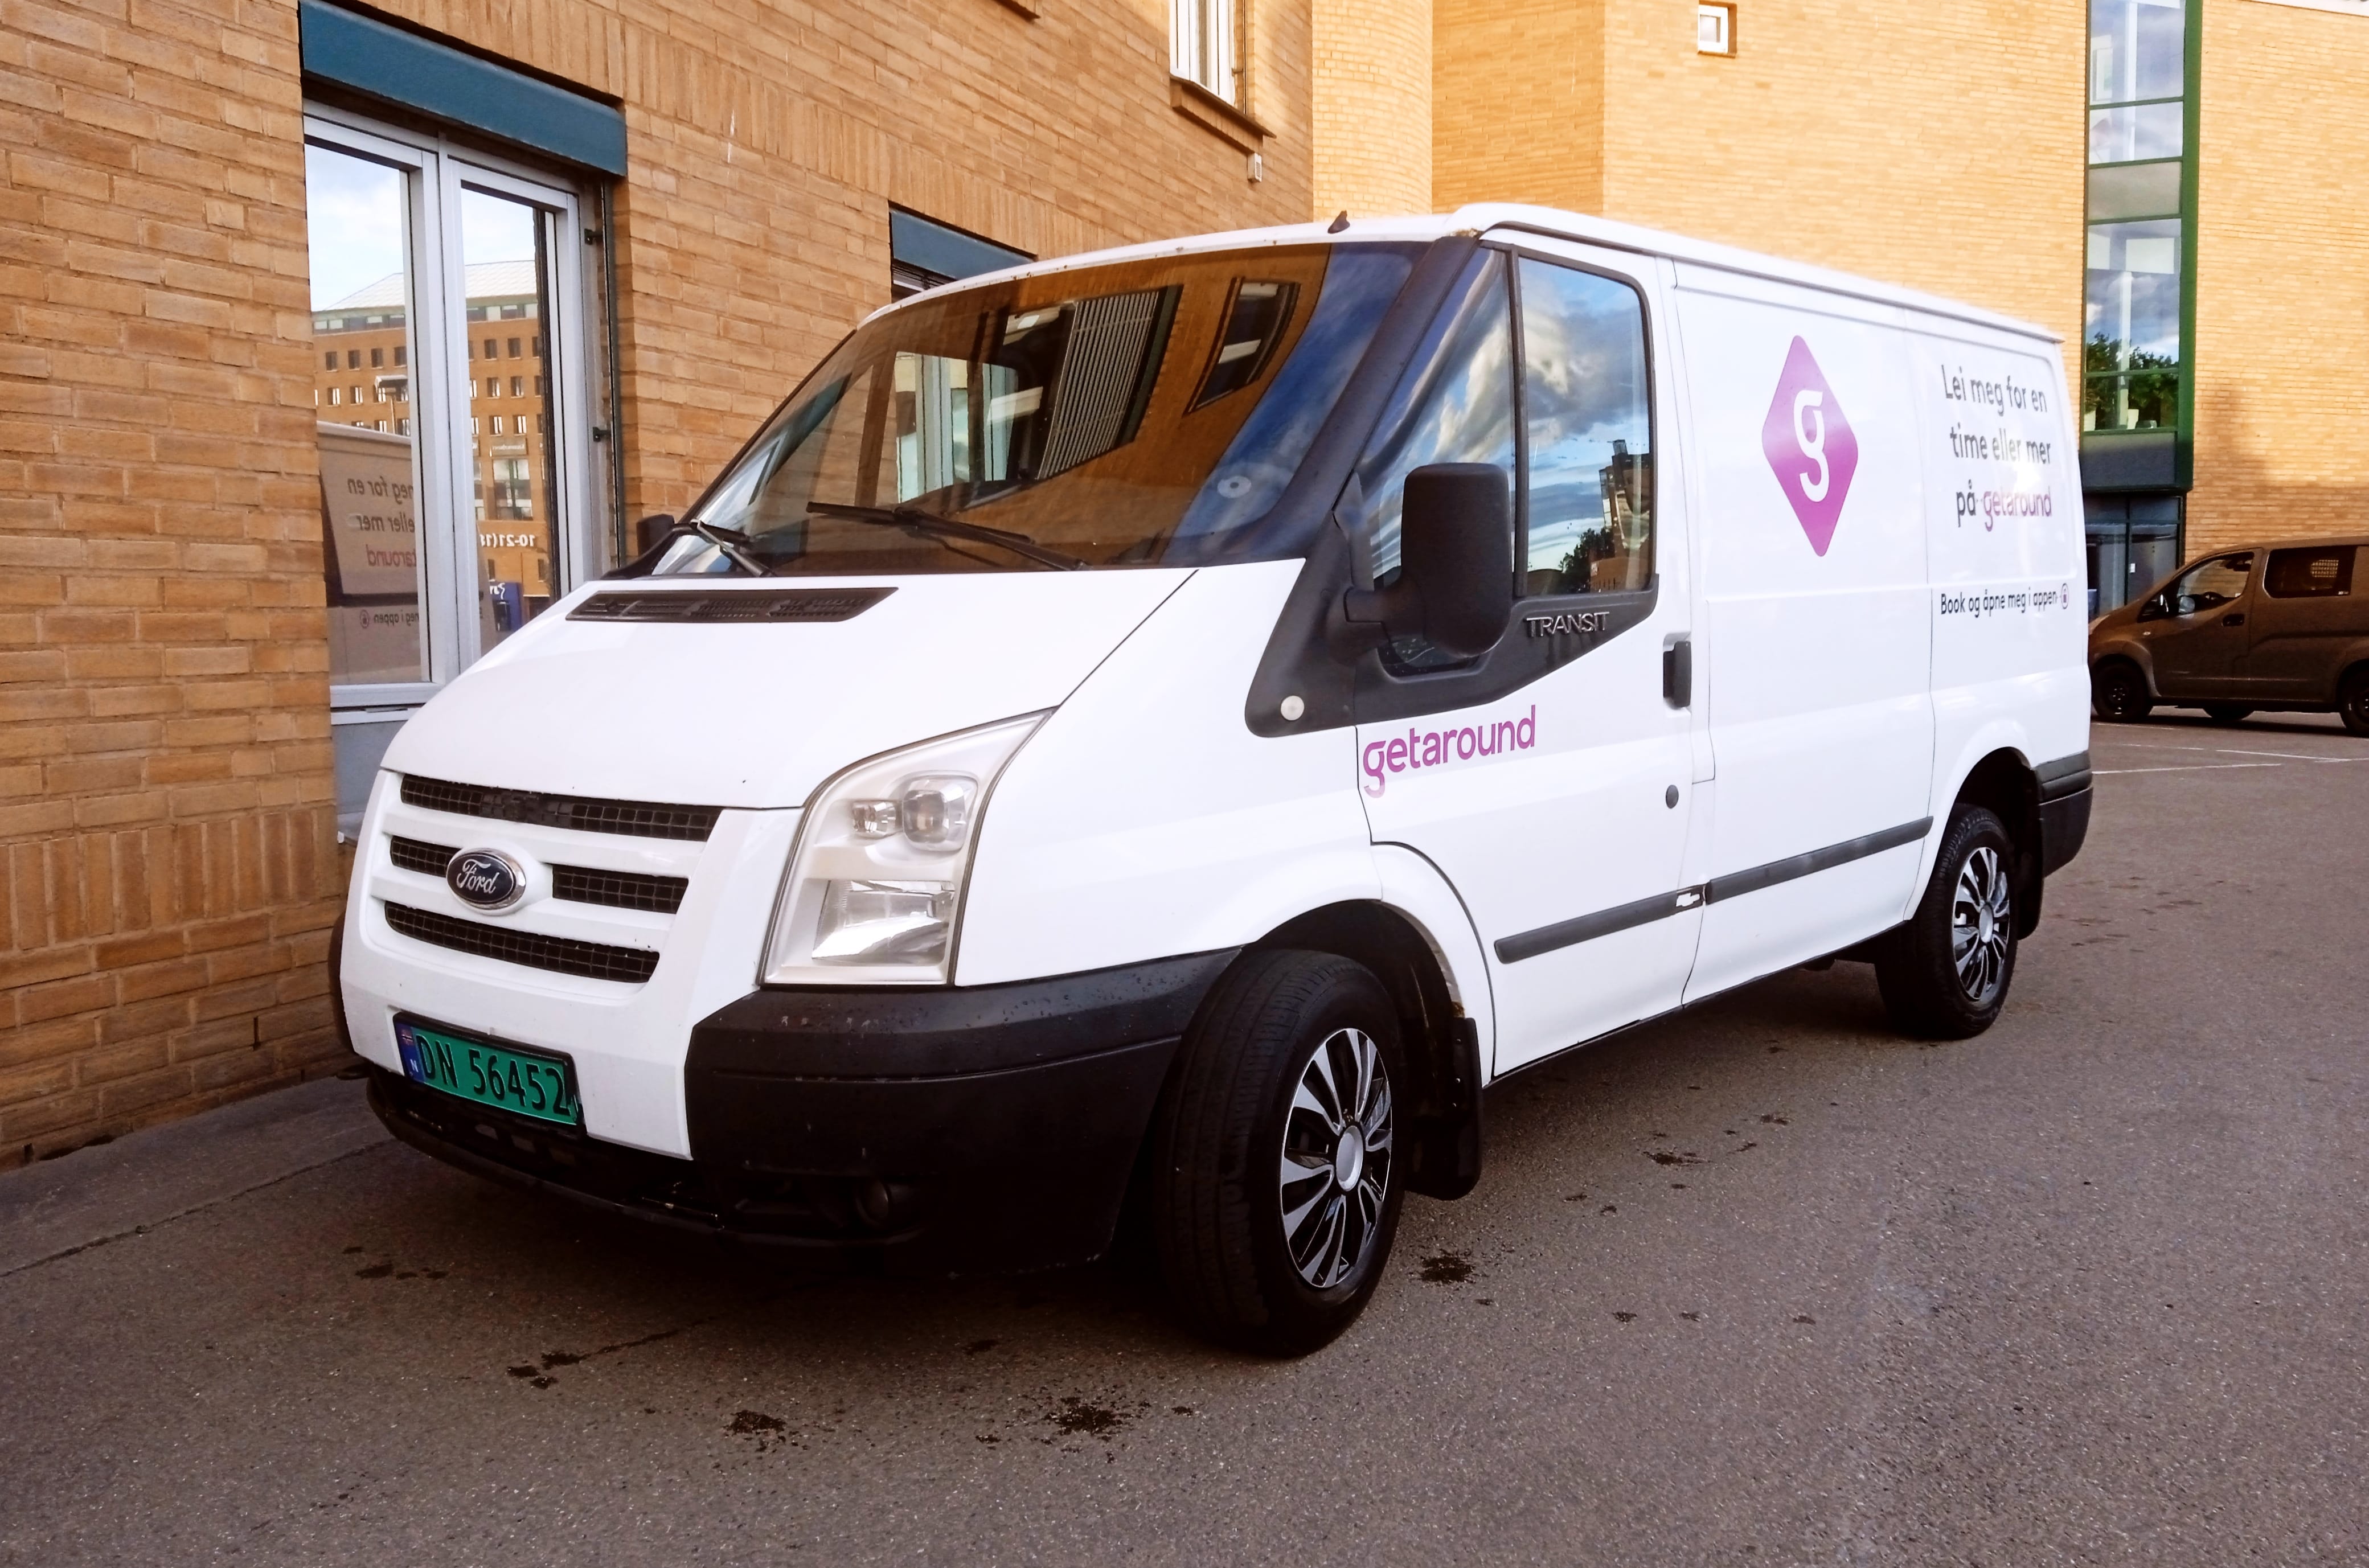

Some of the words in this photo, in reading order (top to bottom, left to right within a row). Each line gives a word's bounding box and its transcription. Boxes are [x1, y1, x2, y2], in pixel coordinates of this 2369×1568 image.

[1941, 364, 1968, 401] Lei
[1970, 379, 2005, 417] meg
[2006, 375, 2027, 411] for
[2032, 388, 2047, 413] en
[1950, 422, 1989, 459] time
[1992, 427, 2022, 462] eller
[2026, 441, 2051, 465] mer
[1956, 479, 1976, 528] på
[1983, 486, 2053, 532] getaround
[1524, 611, 1610, 637] TRANSIT
[1941, 592, 1966, 615] Book
[1968, 596, 1981, 619] og
[1983, 589, 2006, 617] åpne
[2008, 593, 2027, 613] meg
[2033, 590, 2057, 611] appen
[1363, 704, 1536, 798] getaround
[456, 859, 499, 894] Ford
[416, 1033, 458, 1089] DN
[469, 1049, 571, 1116] 56452
